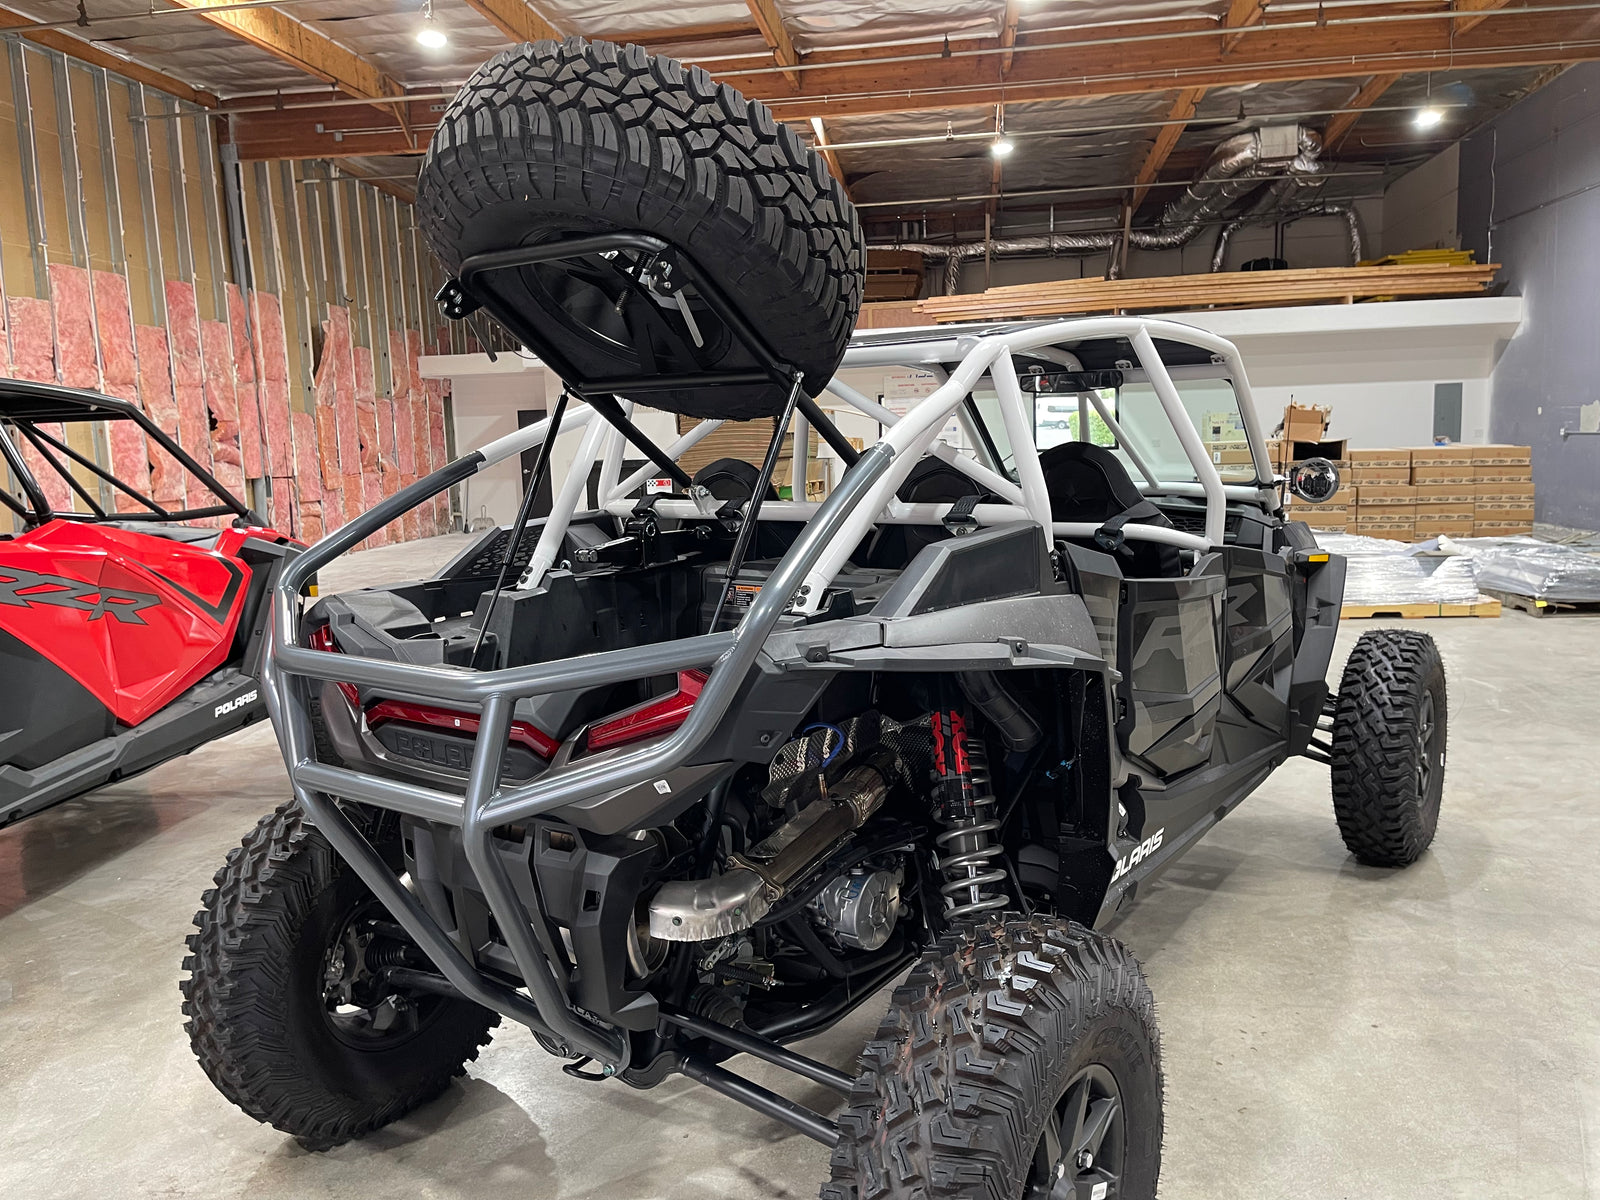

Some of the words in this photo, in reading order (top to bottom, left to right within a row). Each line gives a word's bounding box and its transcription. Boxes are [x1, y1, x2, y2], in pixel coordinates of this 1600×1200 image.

[214, 689, 258, 718] POLARIS
[395, 732, 515, 777] POLAS
[1110, 827, 1165, 884] OLARIS
